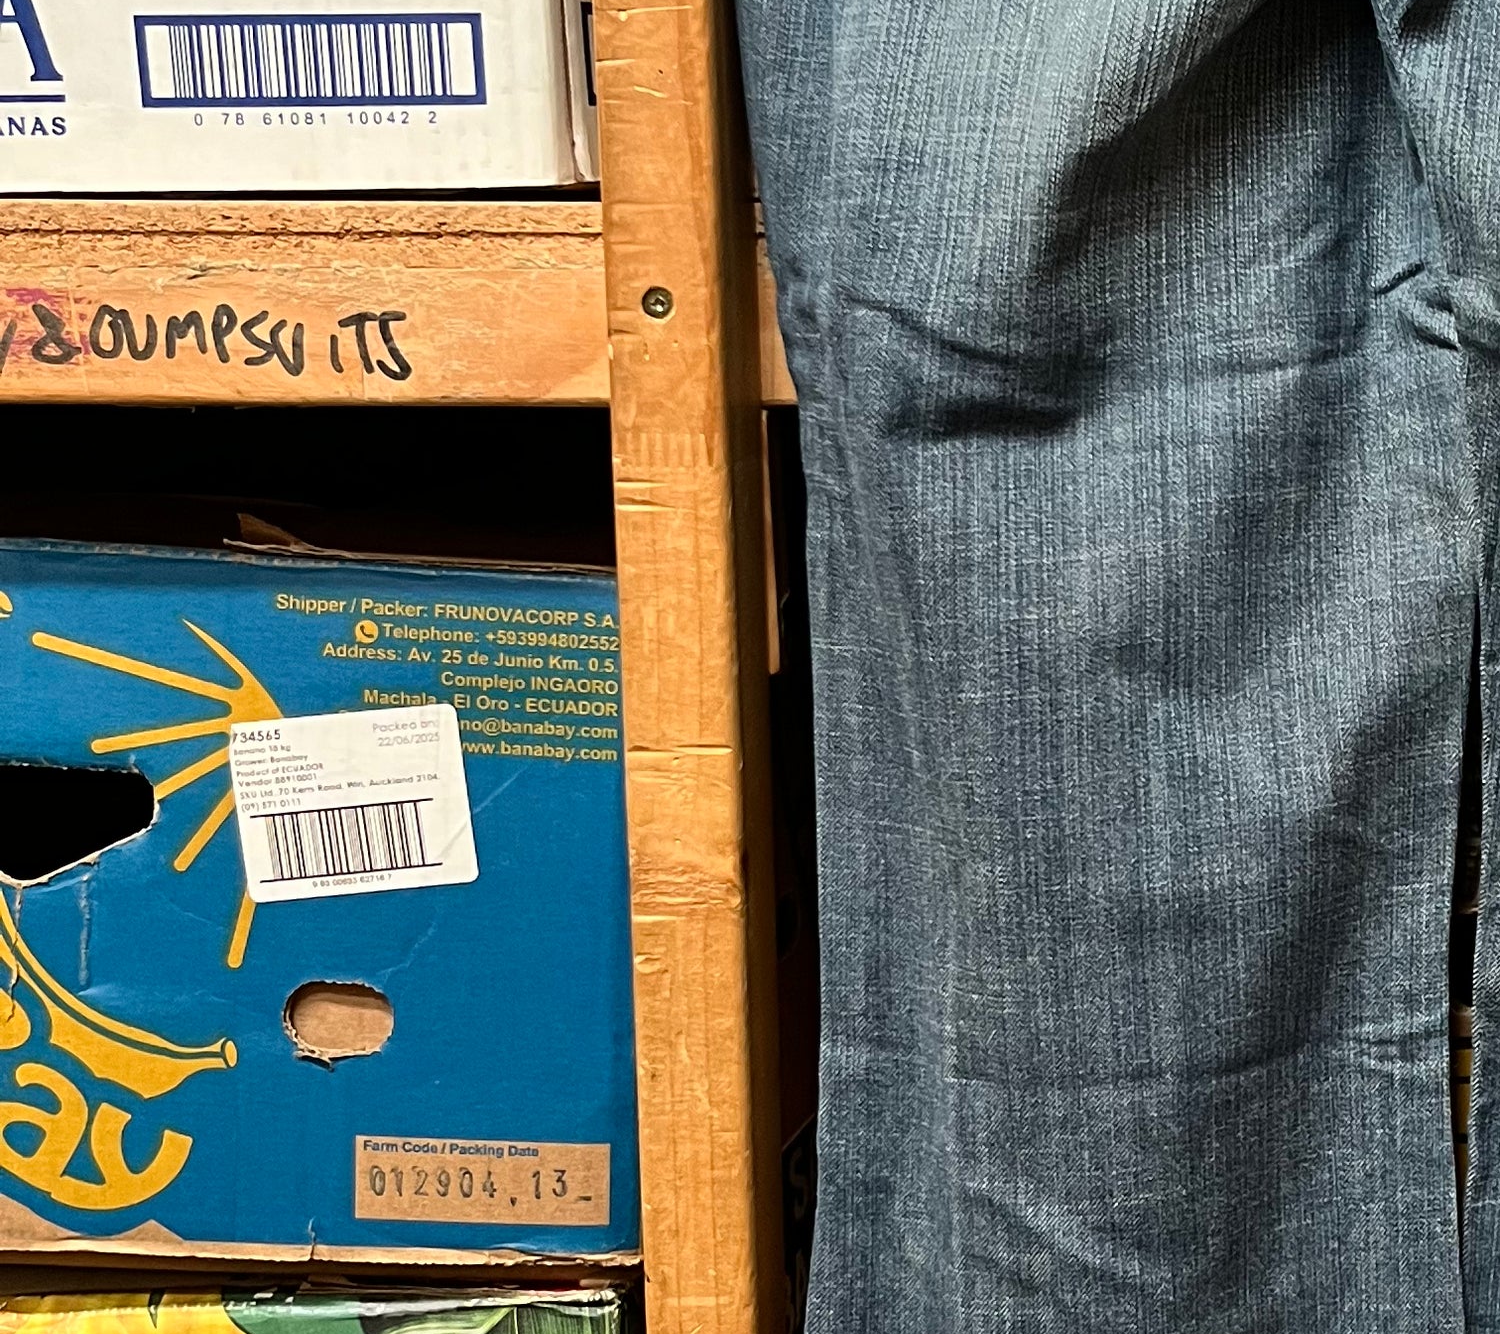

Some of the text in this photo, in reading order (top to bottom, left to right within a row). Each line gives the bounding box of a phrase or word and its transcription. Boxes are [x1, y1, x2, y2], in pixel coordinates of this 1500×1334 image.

[262, 112, 410, 127] 61081 10042
[276, 594, 578, 626] Shipper Packer: FRUNOVACORP
[382, 623, 620, 651] Telephone: +593994802552
[323, 643, 584, 671] Address: Av. 25 de Junio Km.
[441, 672, 619, 696] Complejo INGAORO
[454, 695, 618, 717] El Oro ECUADOR
[363, 1140, 539, 1158] Farm Code Packing Date
